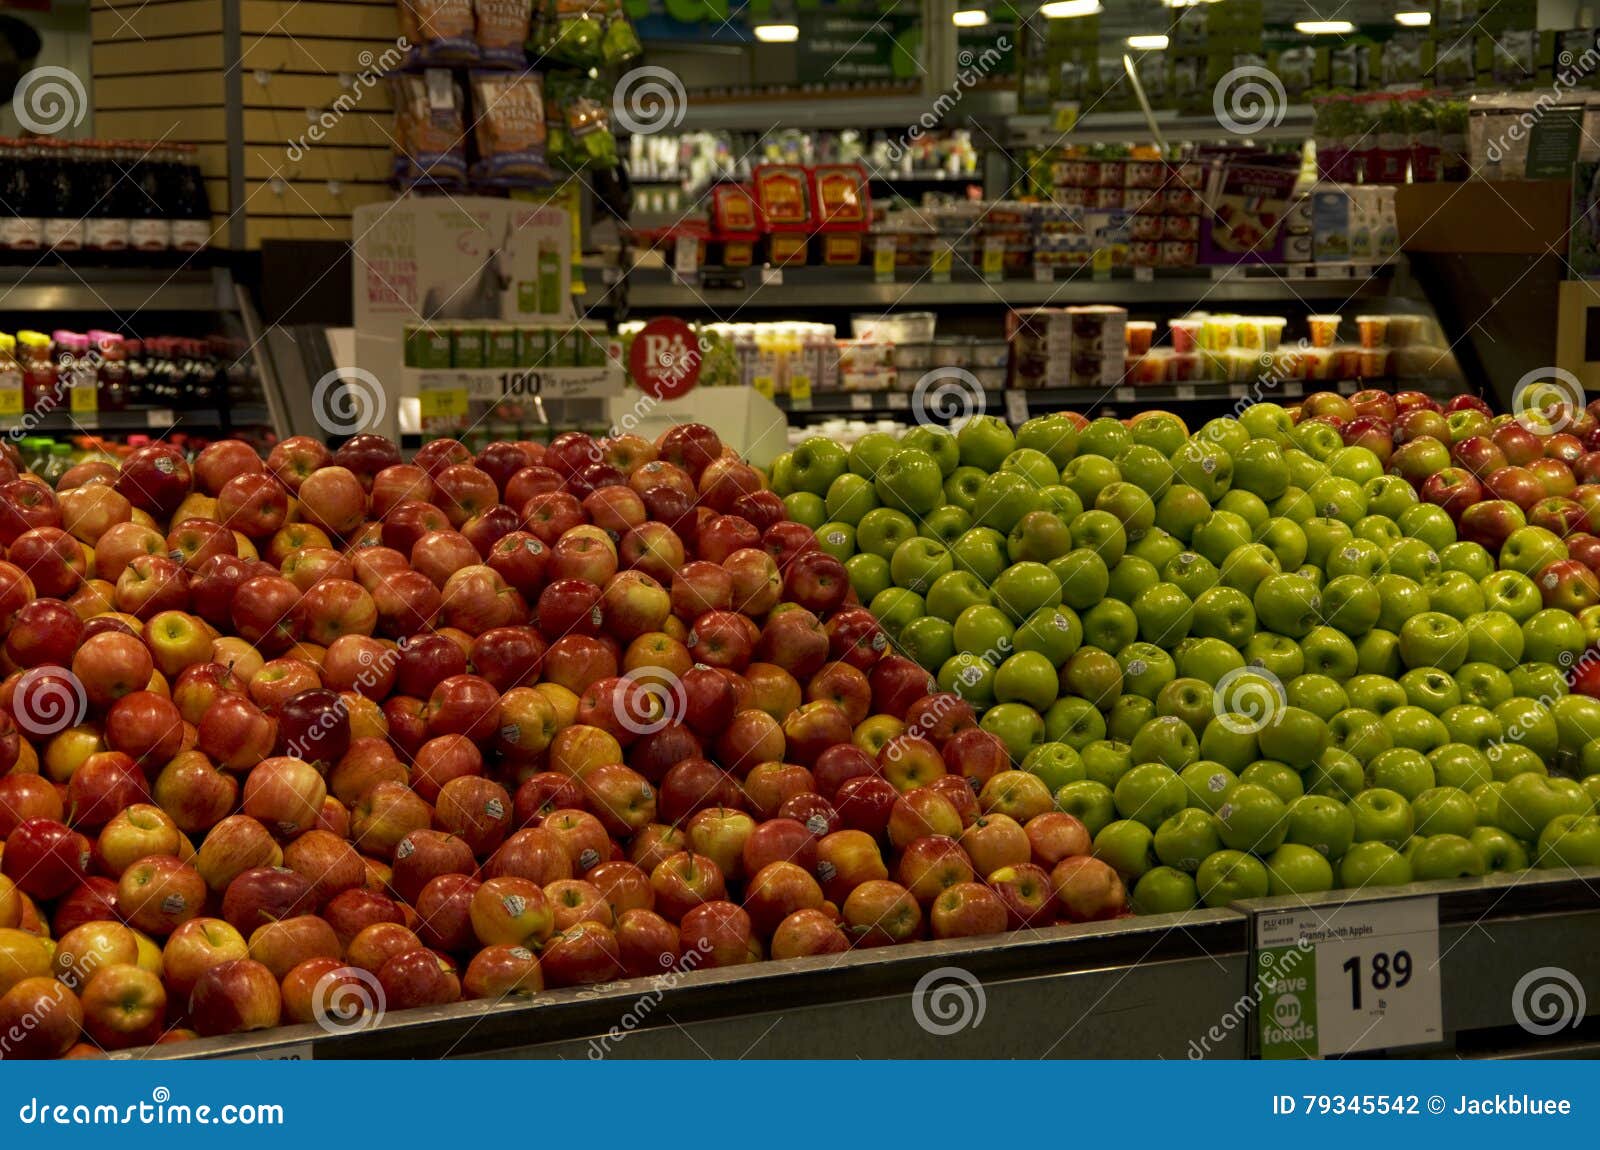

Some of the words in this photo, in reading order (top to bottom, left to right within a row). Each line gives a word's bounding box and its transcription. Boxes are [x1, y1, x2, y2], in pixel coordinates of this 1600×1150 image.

[1299, 930, 1326, 940] Granny
[1327, 928, 1348, 937] Smith
[1349, 925, 1373, 937] Apples
[1276, 1003, 1299, 1018] on
[1263, 1021, 1314, 1045] foods
